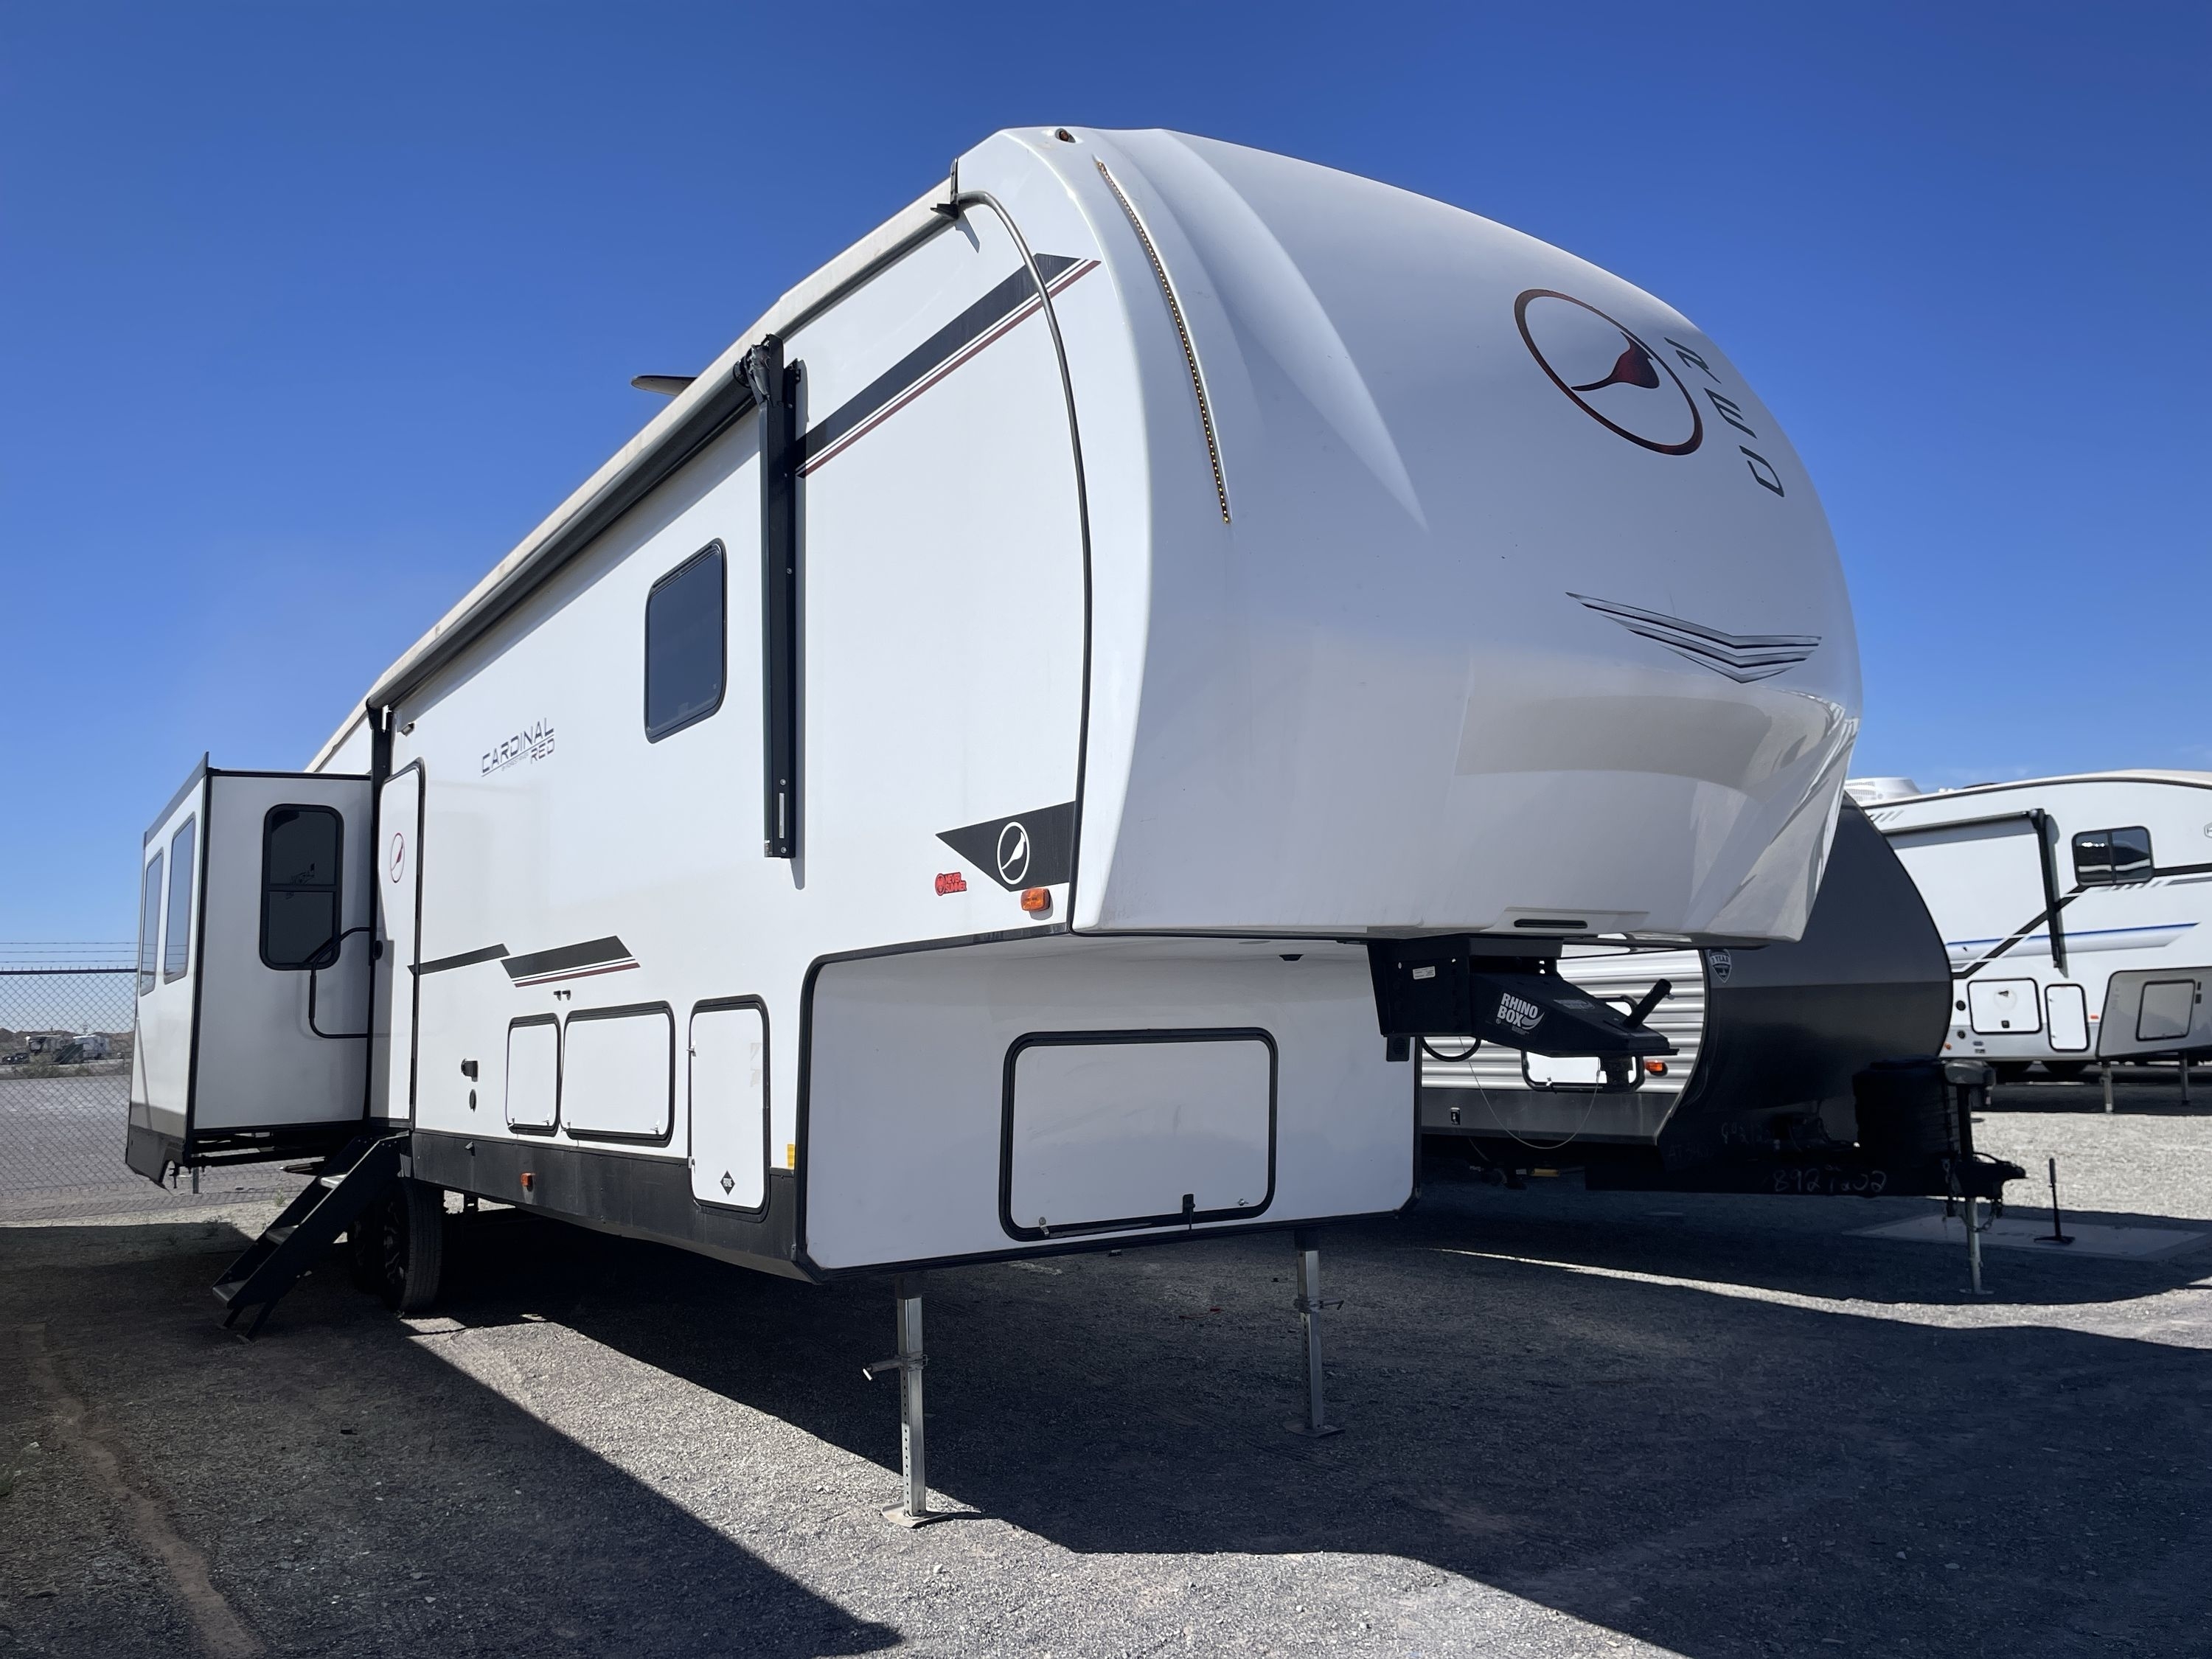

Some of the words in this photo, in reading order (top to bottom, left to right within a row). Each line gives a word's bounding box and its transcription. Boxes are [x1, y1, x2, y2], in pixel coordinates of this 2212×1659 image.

[1663, 336, 1785, 498] RED
[482, 717, 554, 773] CARDINAL
[531, 738, 555, 765] RED
[1497, 1005, 1524, 1028] BOX
[1501, 992, 1538, 1019] RHINO
